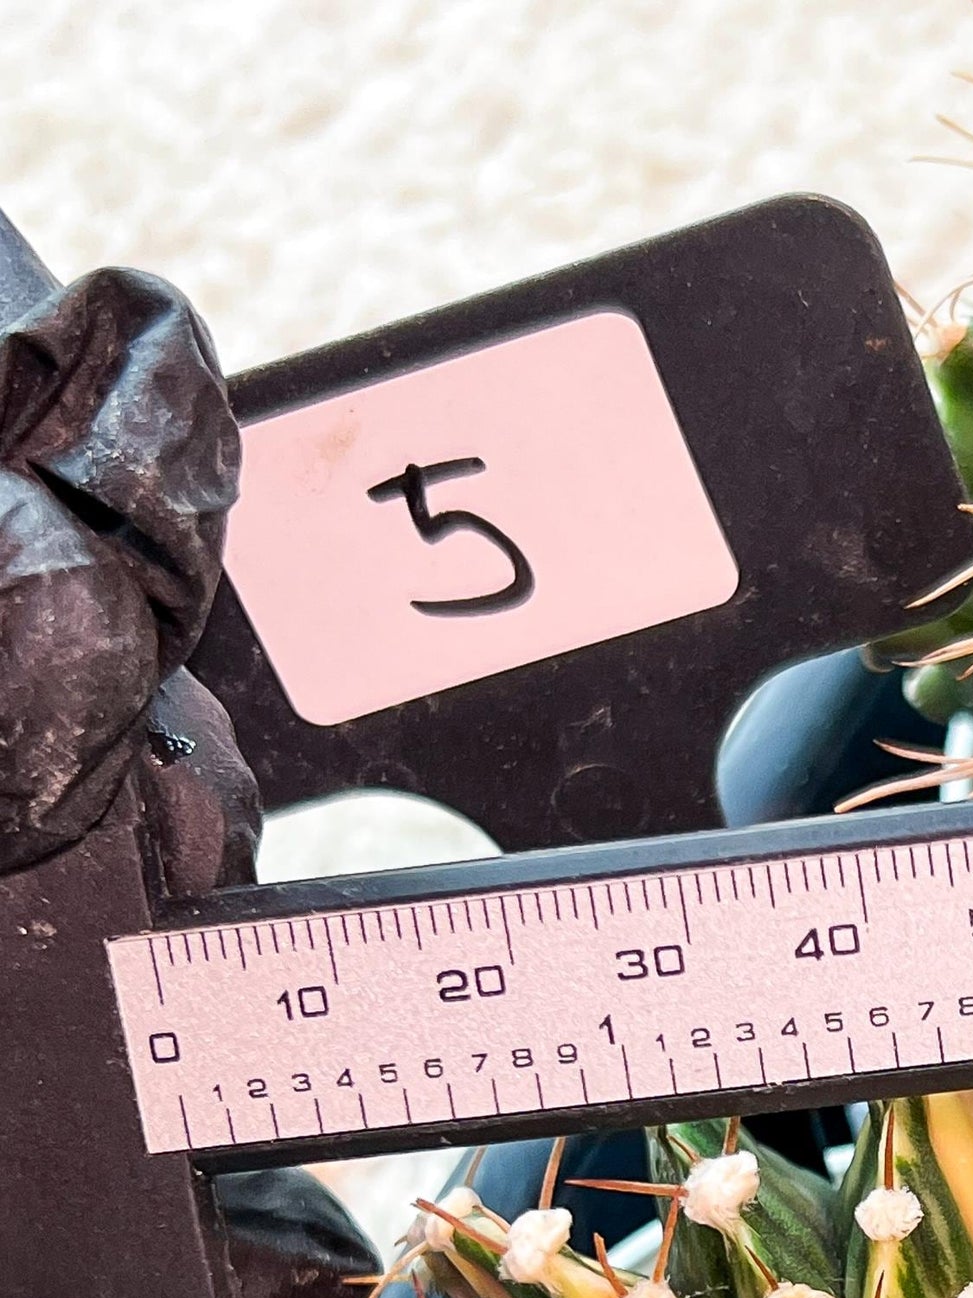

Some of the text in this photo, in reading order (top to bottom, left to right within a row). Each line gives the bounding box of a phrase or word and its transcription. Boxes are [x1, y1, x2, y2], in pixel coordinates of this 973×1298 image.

[366, 456, 536, 617] 5
[276, 985, 330, 1021] 10
[436, 964, 507, 1003] 20
[615, 944, 686, 981] 30
[794, 923, 861, 961] 40
[148, 1031, 181, 1064] 0
[212, 1084, 223, 1102] 1
[246, 1078, 269, 1099] 2
[291, 1072, 312, 1093] 3
[336, 1068, 355, 1088] 4
[378, 1062, 399, 1084] 5
[423, 1057, 444, 1079] 6
[471, 1052, 490, 1073] 7
[511, 1047, 534, 1069] 8
[556, 1043, 578, 1065] 9
[598, 1014, 616, 1045] 1
[655, 1033, 666, 1052] 1
[690, 1027, 713, 1049] 2
[735, 1022, 756, 1042] 3
[780, 1017, 799, 1037] 4
[824, 1011, 844, 1033] 5
[868, 1006, 890, 1028] 6
[917, 1001, 935, 1021] 7
